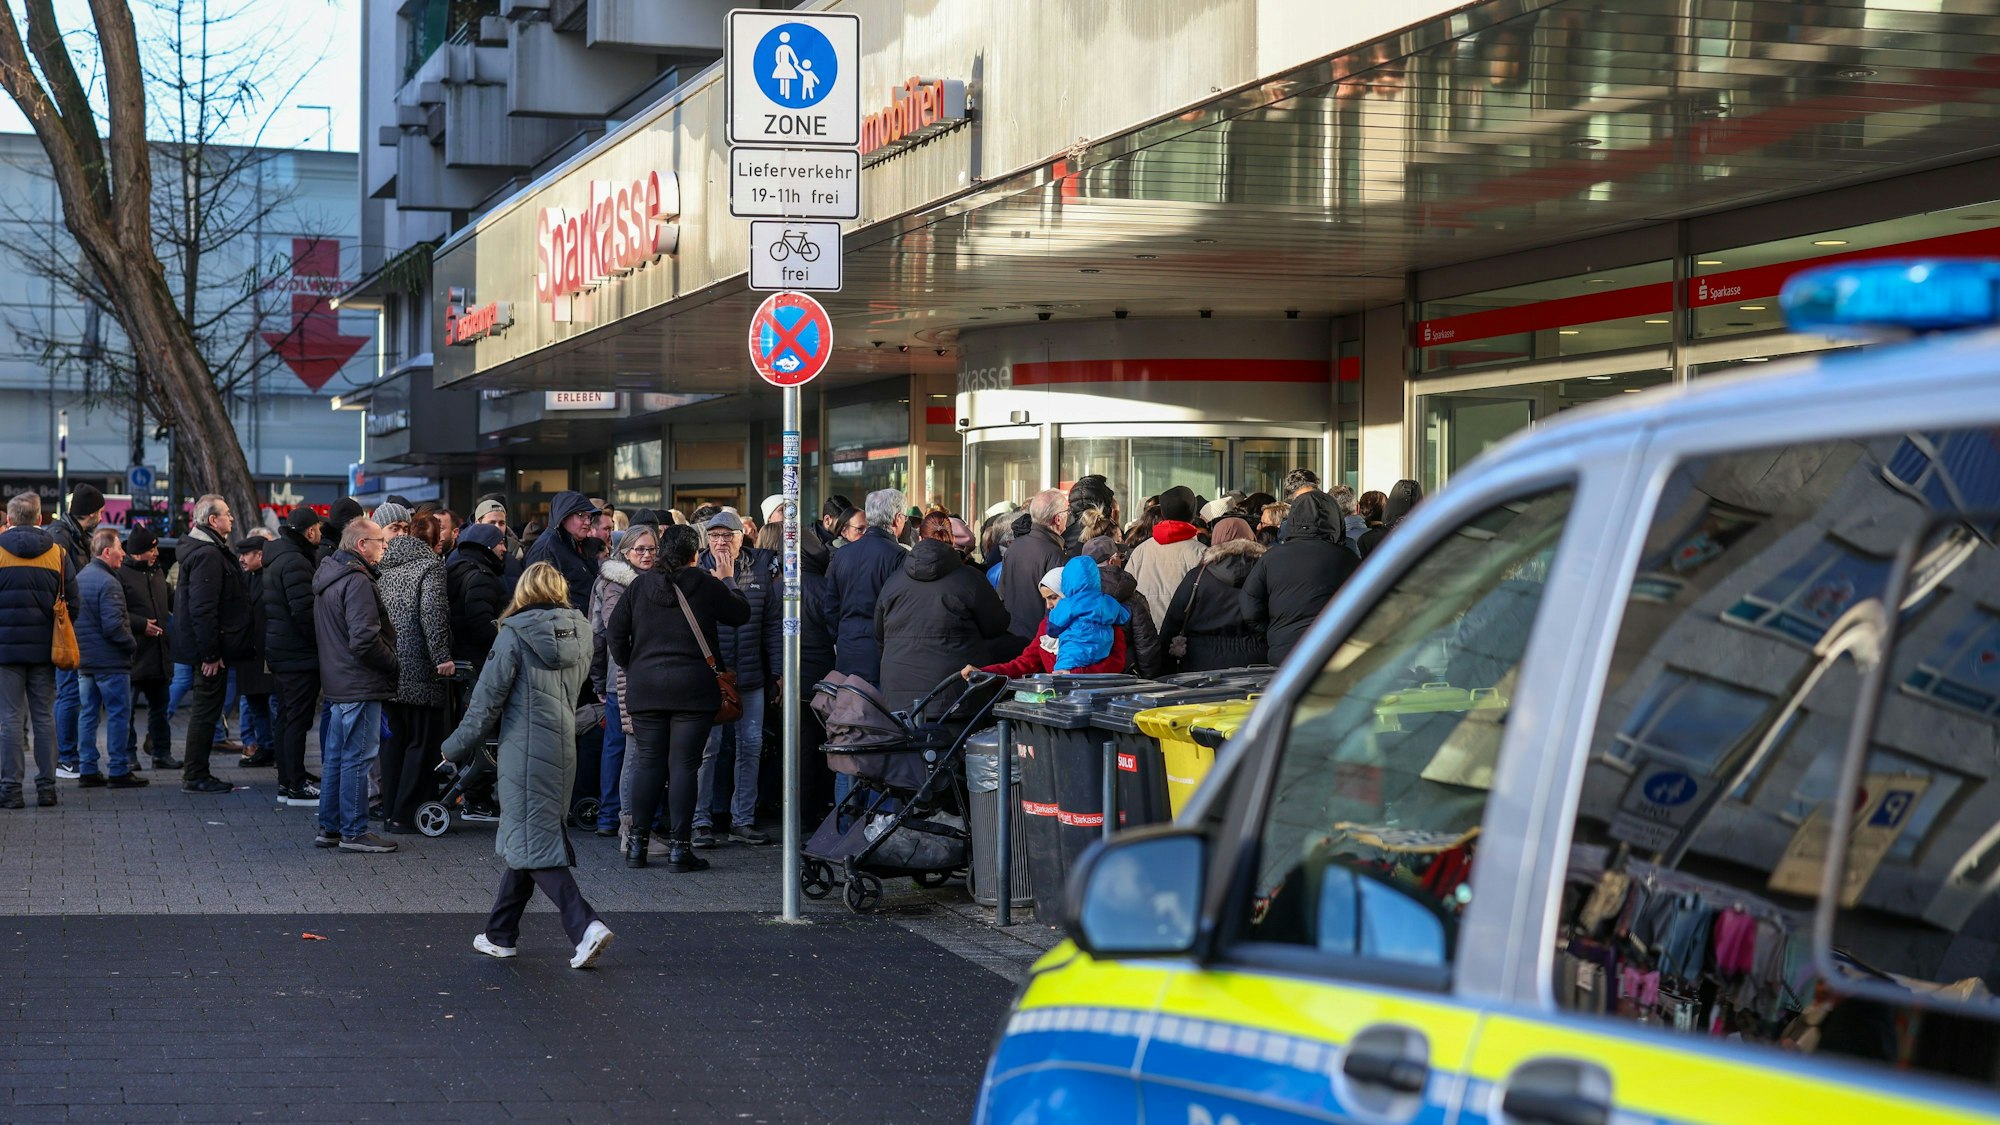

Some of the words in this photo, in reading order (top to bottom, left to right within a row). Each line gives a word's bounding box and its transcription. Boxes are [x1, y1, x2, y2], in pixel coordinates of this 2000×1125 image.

[860, 75, 945, 156] mobilien
[764, 114, 827, 136] ZONE
[738, 162, 853, 180] Lieferverkehr
[752, 188, 801, 204] 19-11h
[811, 189, 840, 205] frei
[535, 170, 665, 322] Sparkasse
[781, 266, 810, 282] frei
[1710, 285, 1741, 301] Sparkasse
[1432, 329, 1455, 342] Sparkasse
[557, 392, 602, 403] ERLEBEN
[1118, 755, 1134, 769] SULO
